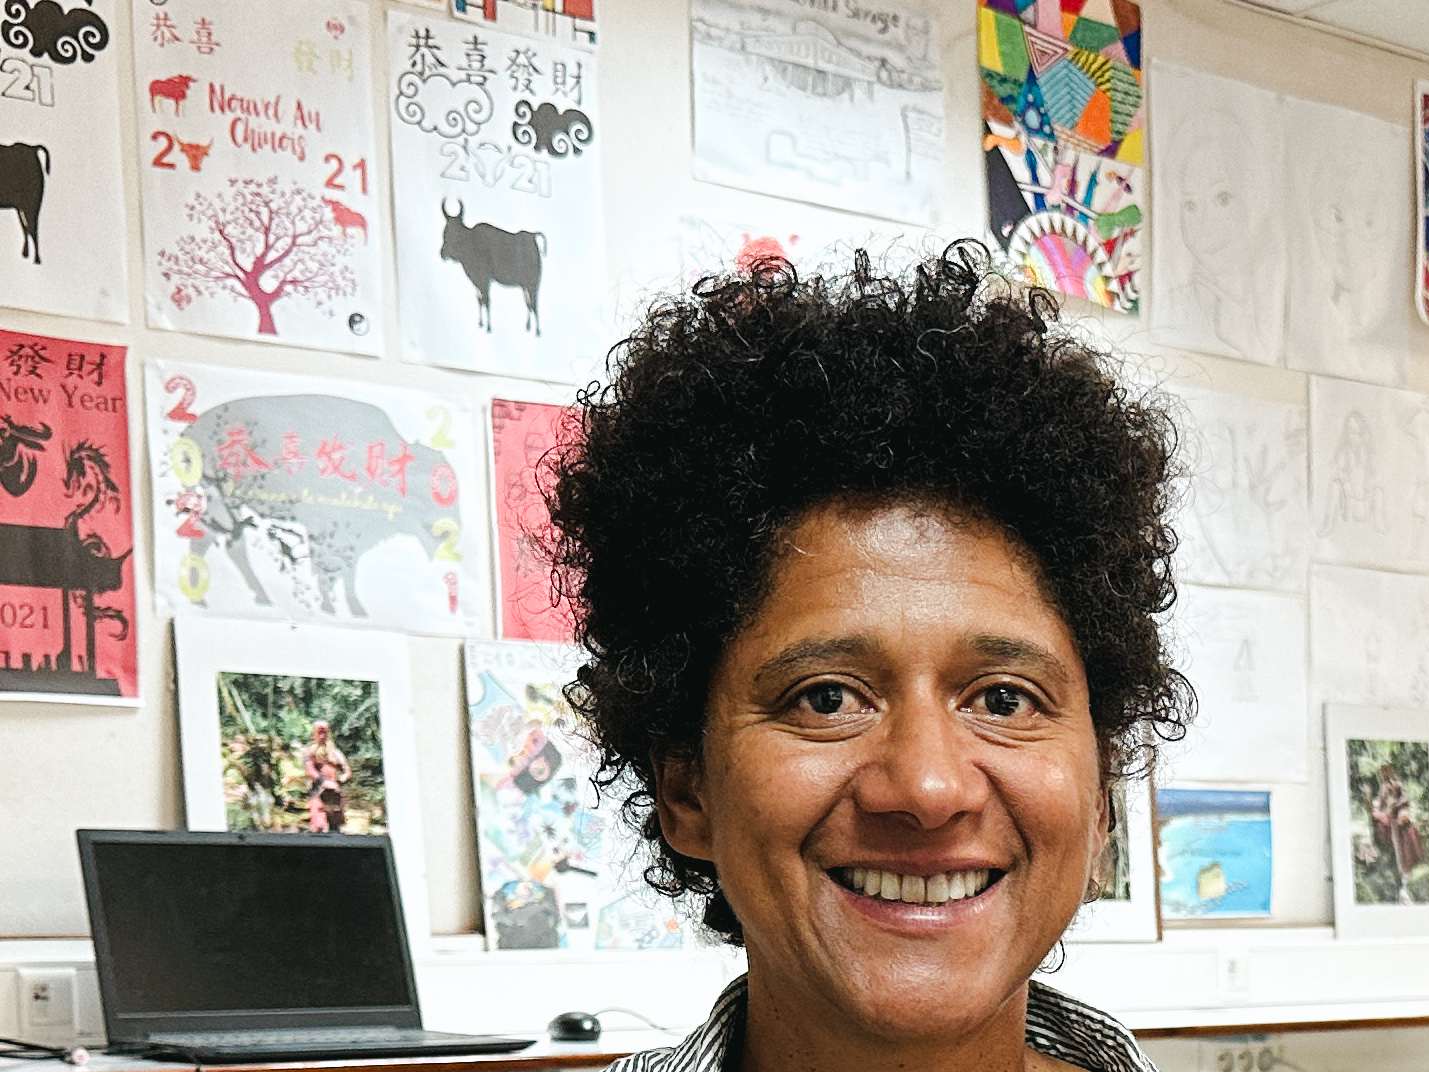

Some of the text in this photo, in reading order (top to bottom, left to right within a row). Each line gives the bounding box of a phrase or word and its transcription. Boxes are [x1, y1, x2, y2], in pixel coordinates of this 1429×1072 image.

[208, 81, 322, 133] Nouvel An
[229, 115, 306, 163] Chinois
[60, 382, 123, 413] Year
